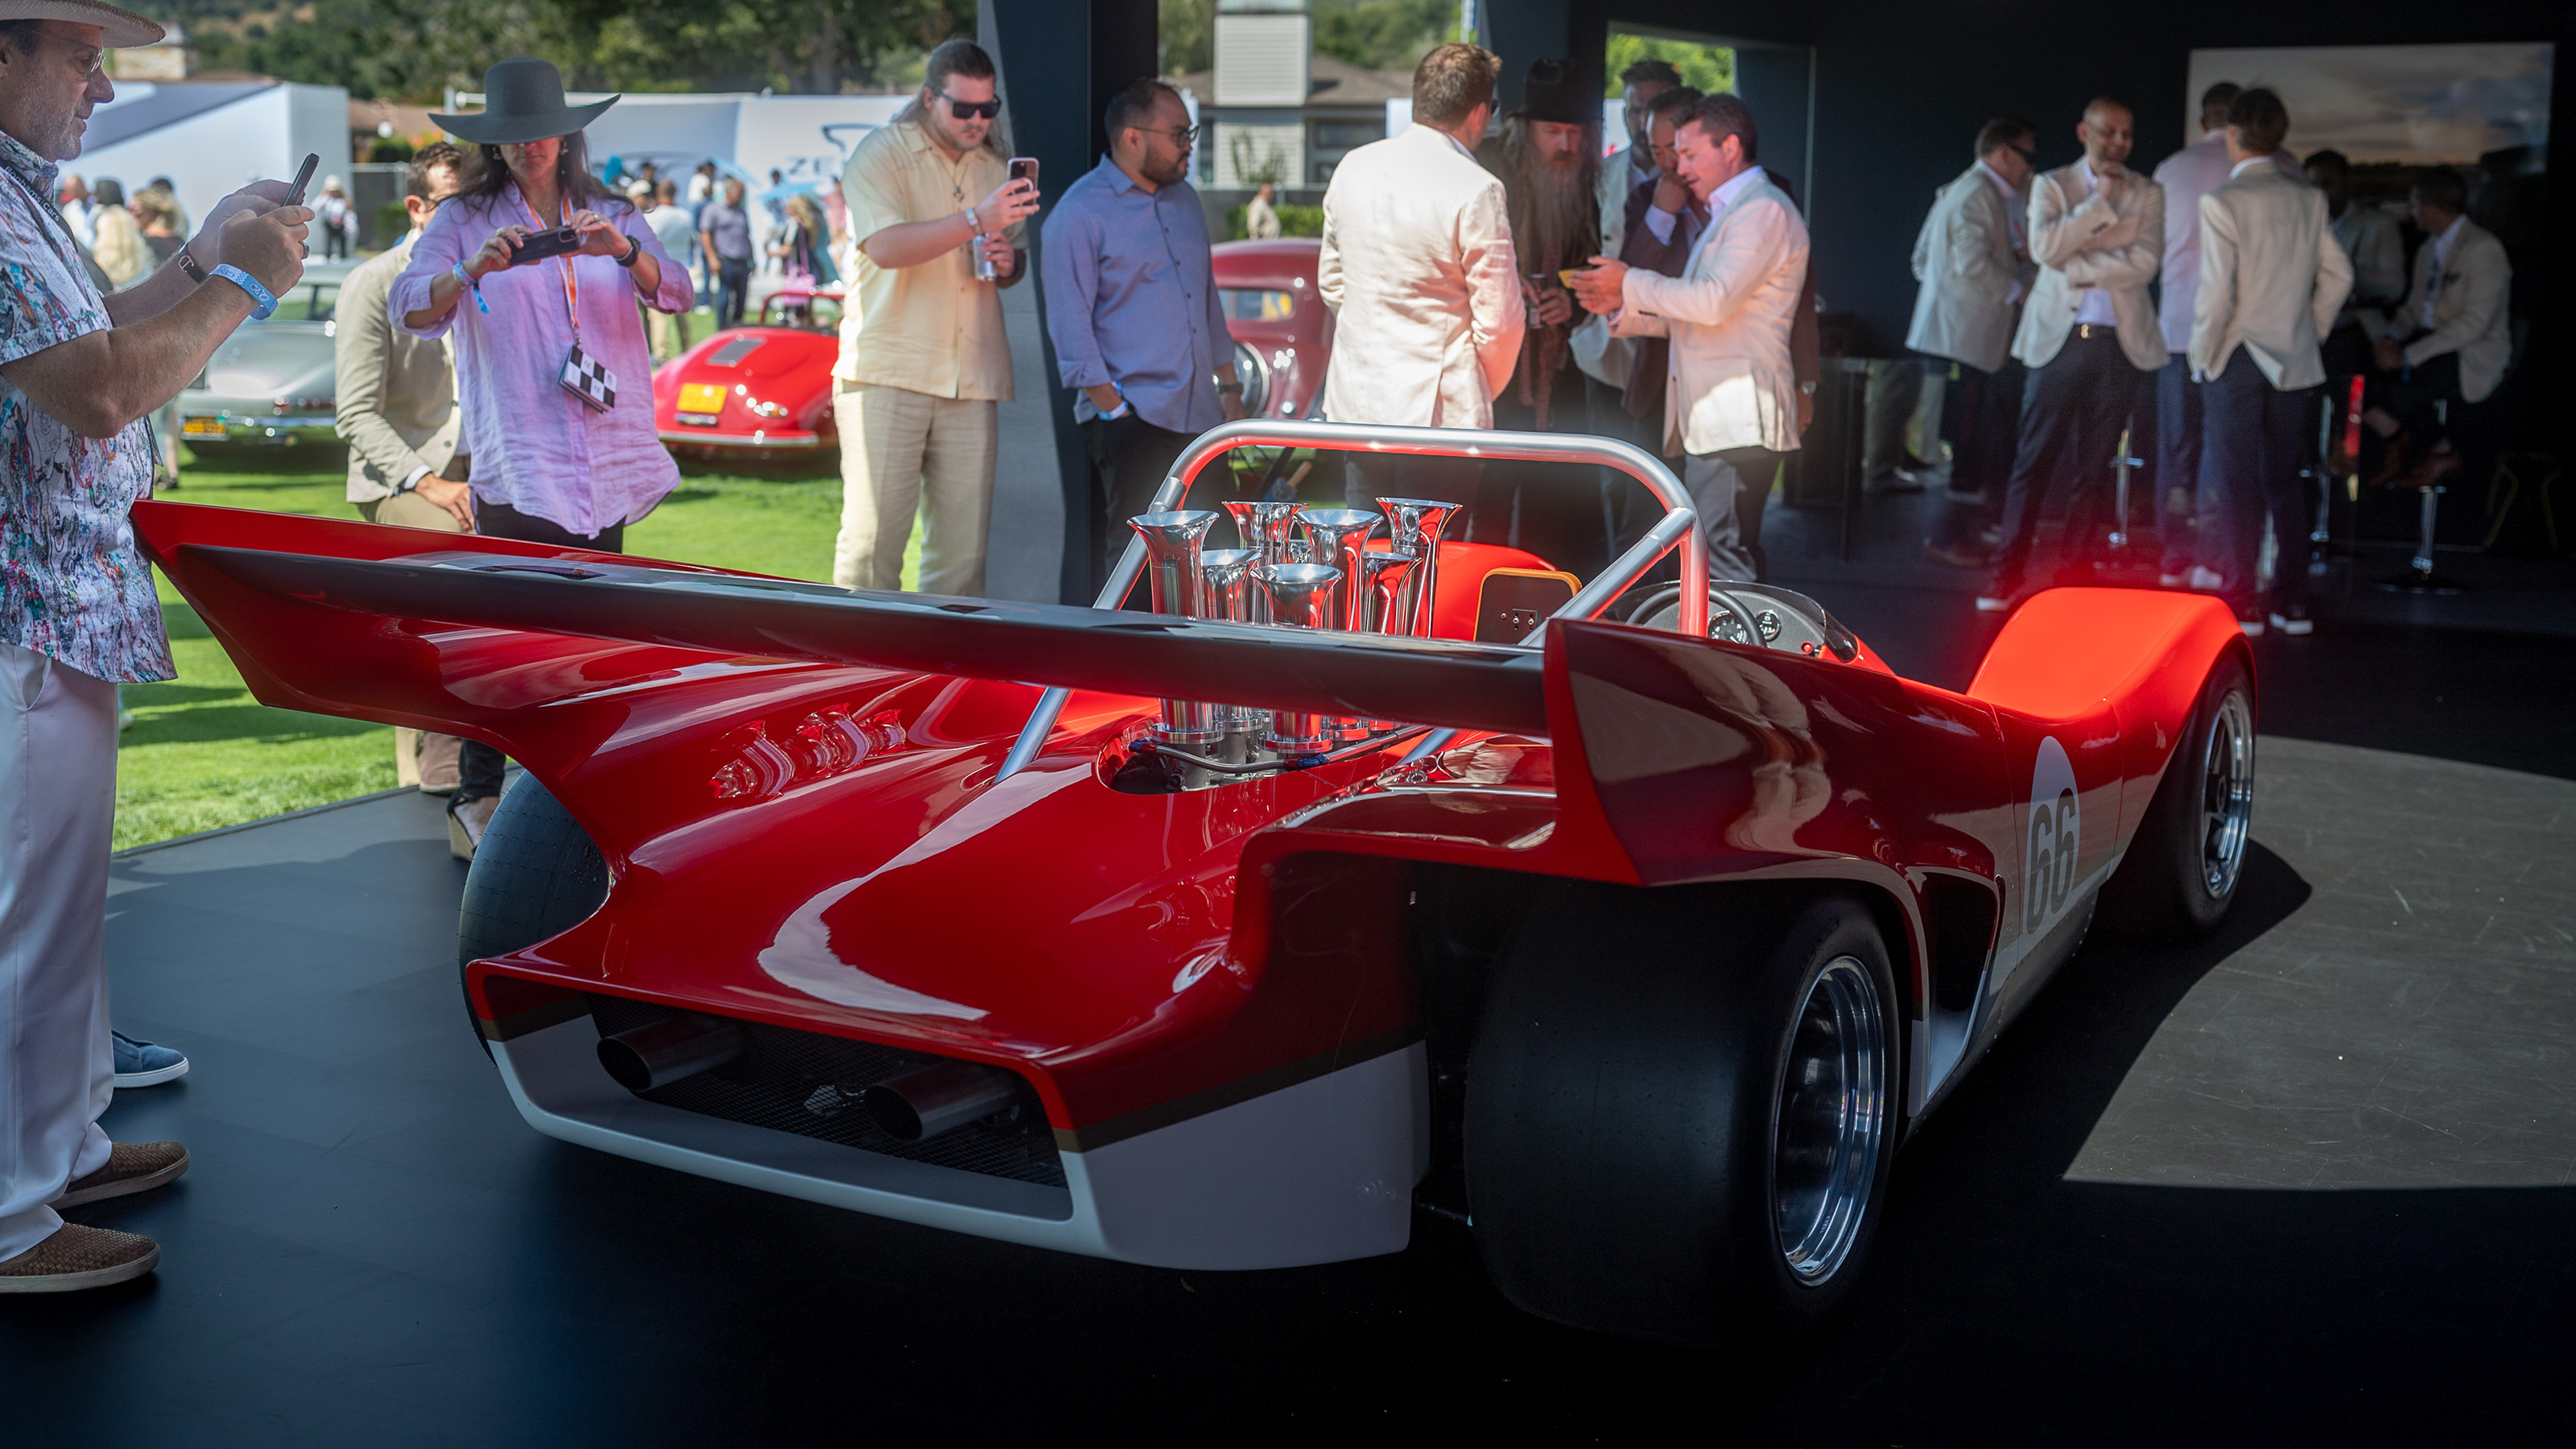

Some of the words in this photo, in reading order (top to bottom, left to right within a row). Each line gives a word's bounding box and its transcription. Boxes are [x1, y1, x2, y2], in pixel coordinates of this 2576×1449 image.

[787, 155, 845, 175] ZE
[5, 166, 41, 203] Bonhams
[43, 203, 60, 221] Cars
[2026, 787, 2075, 935] 66
